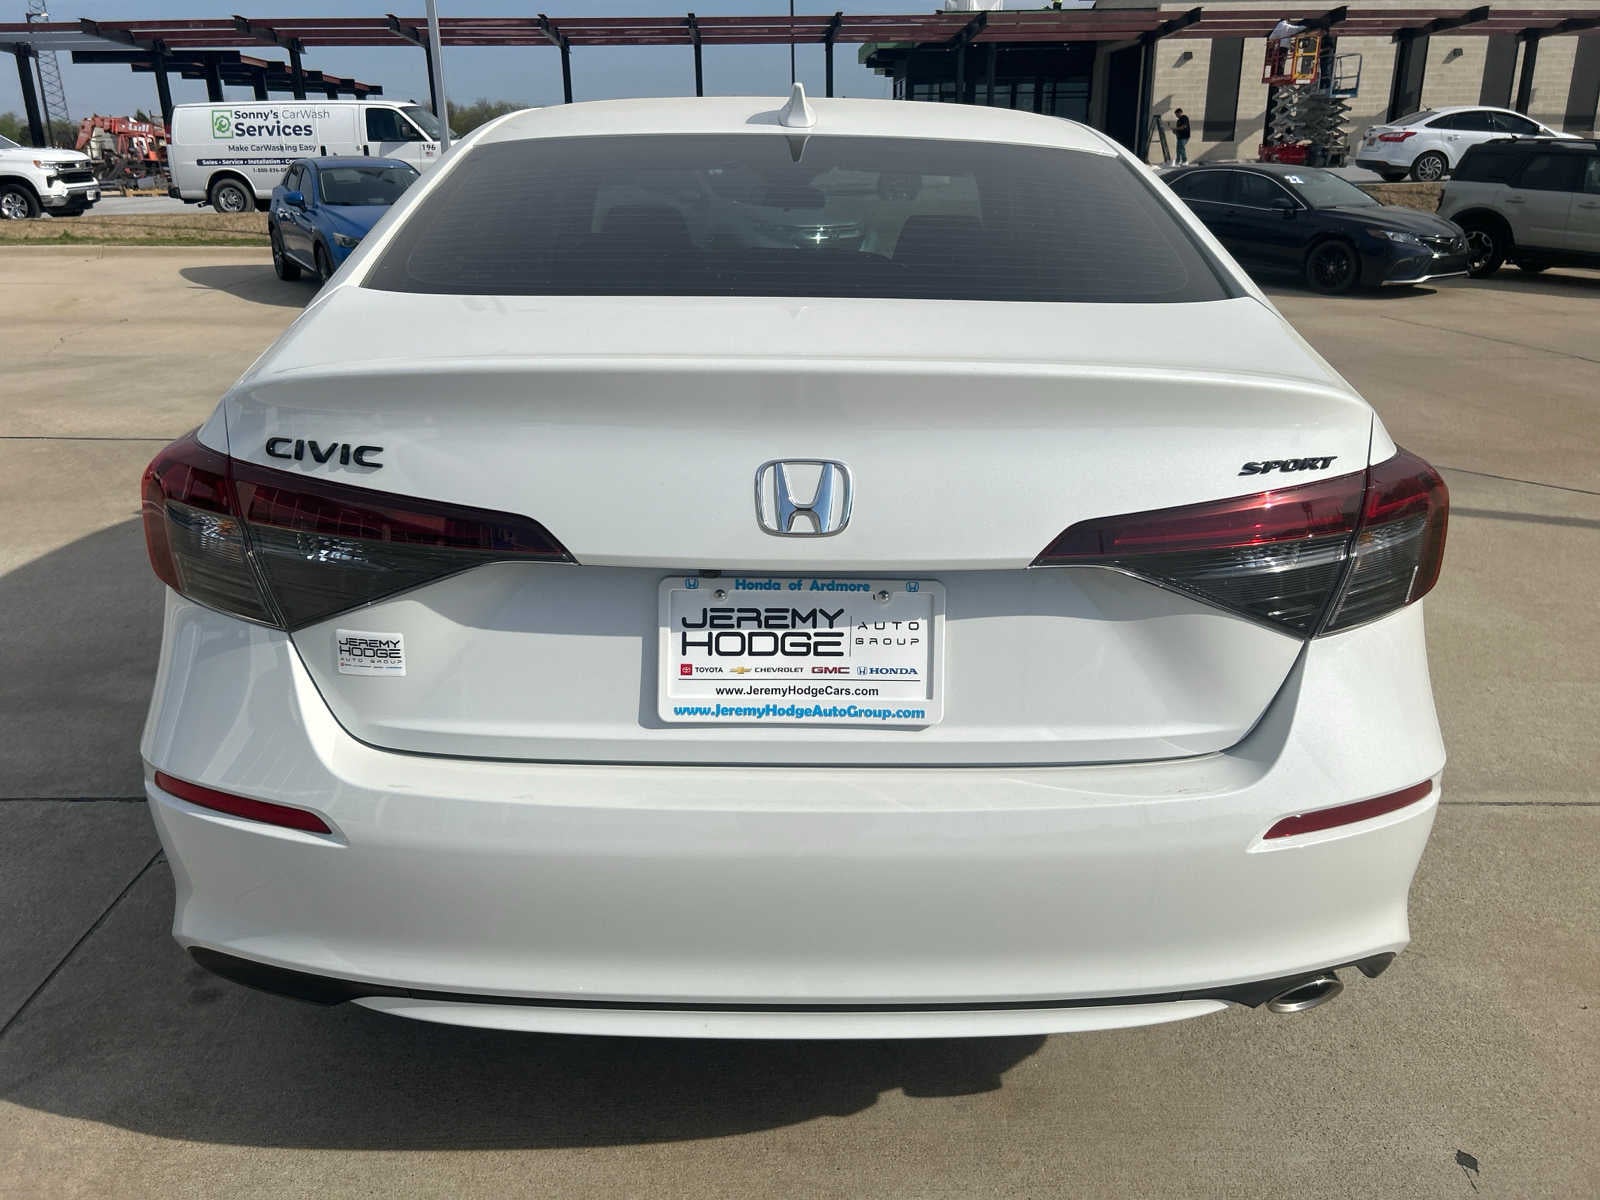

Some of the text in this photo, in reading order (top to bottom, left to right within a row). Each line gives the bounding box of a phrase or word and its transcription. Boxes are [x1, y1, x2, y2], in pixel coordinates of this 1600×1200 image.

[234, 110, 330, 121] Sonny's CarWash
[234, 120, 313, 137] Services
[250, 144, 298, 153] CarWashing
[299, 144, 317, 152] Easy
[265, 437, 384, 468] CIVIC
[1238, 455, 1338, 476] SPORT
[735, 579, 871, 592] Honda of Ardmore
[681, 607, 845, 629] JEREMY
[857, 621, 920, 631] AUTO
[339, 637, 401, 648] JEREMY
[681, 631, 845, 657] HODGE
[855, 637, 920, 646] GROUP
[339, 645, 402, 659] HODGE
[811, 666, 850, 674] GMC
[868, 667, 918, 675] HONDA
[715, 685, 879, 698] www.JeremyHodgeCars.com
[673, 703, 926, 721] www.JeremyHodgeAutoGroup.com
